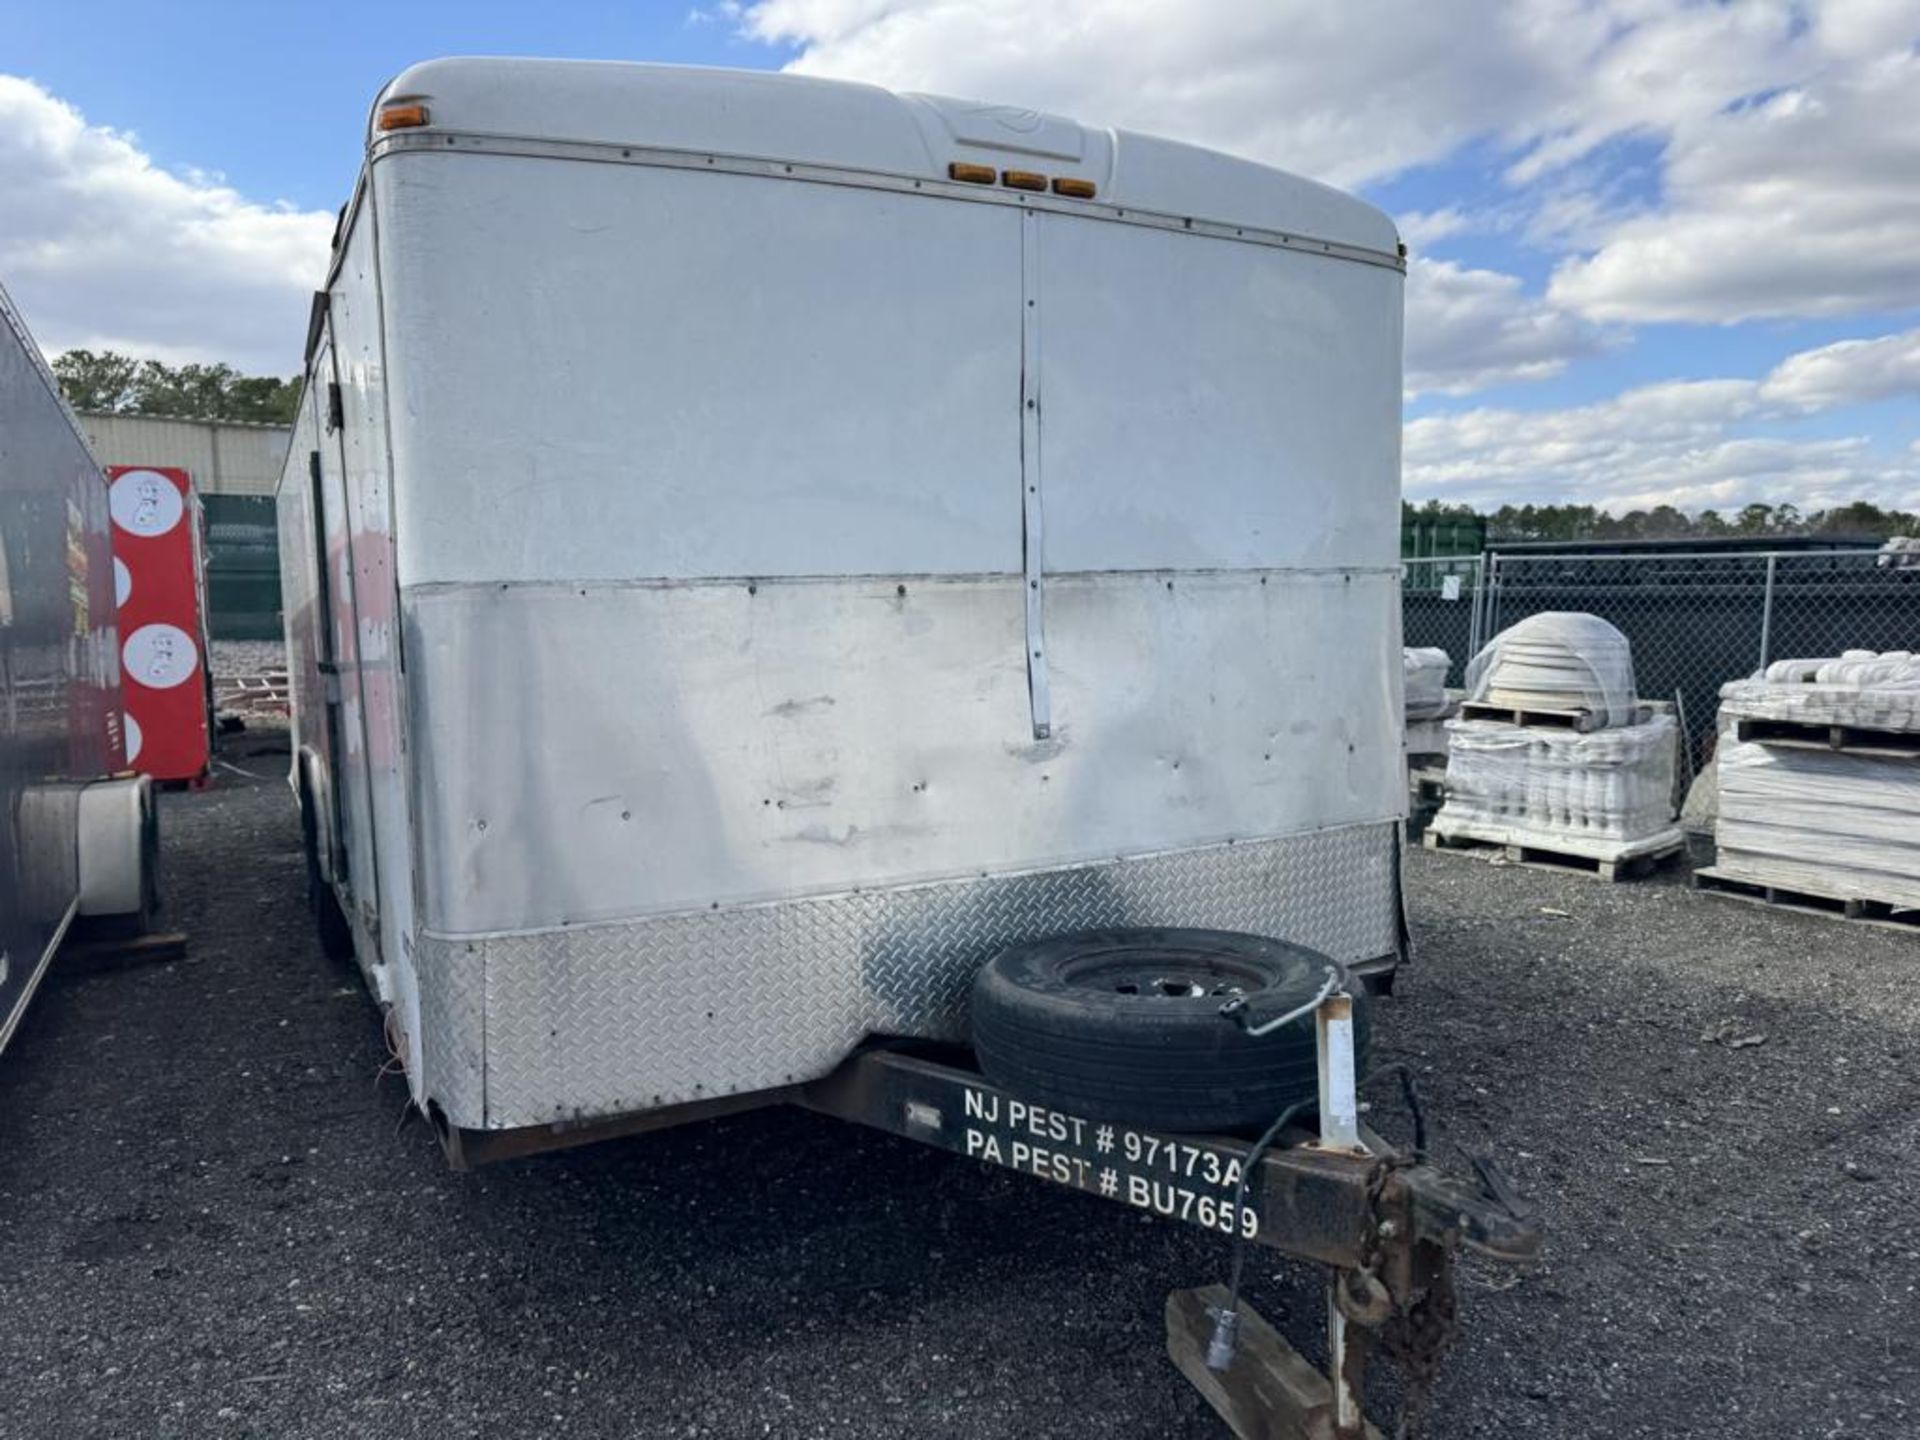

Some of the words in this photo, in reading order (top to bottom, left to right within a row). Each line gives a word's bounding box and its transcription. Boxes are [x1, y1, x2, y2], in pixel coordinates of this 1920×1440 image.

[965, 1088, 999, 1122] NJ
[1009, 1100, 1087, 1146] PEST
[1096, 1125, 1115, 1153] #
[1124, 1132, 1250, 1193] 97173A
[966, 1128, 1003, 1165] PA
[1012, 1141, 1091, 1188] PEST
[1099, 1167, 1118, 1197] #
[1128, 1174, 1259, 1238] BU7659
